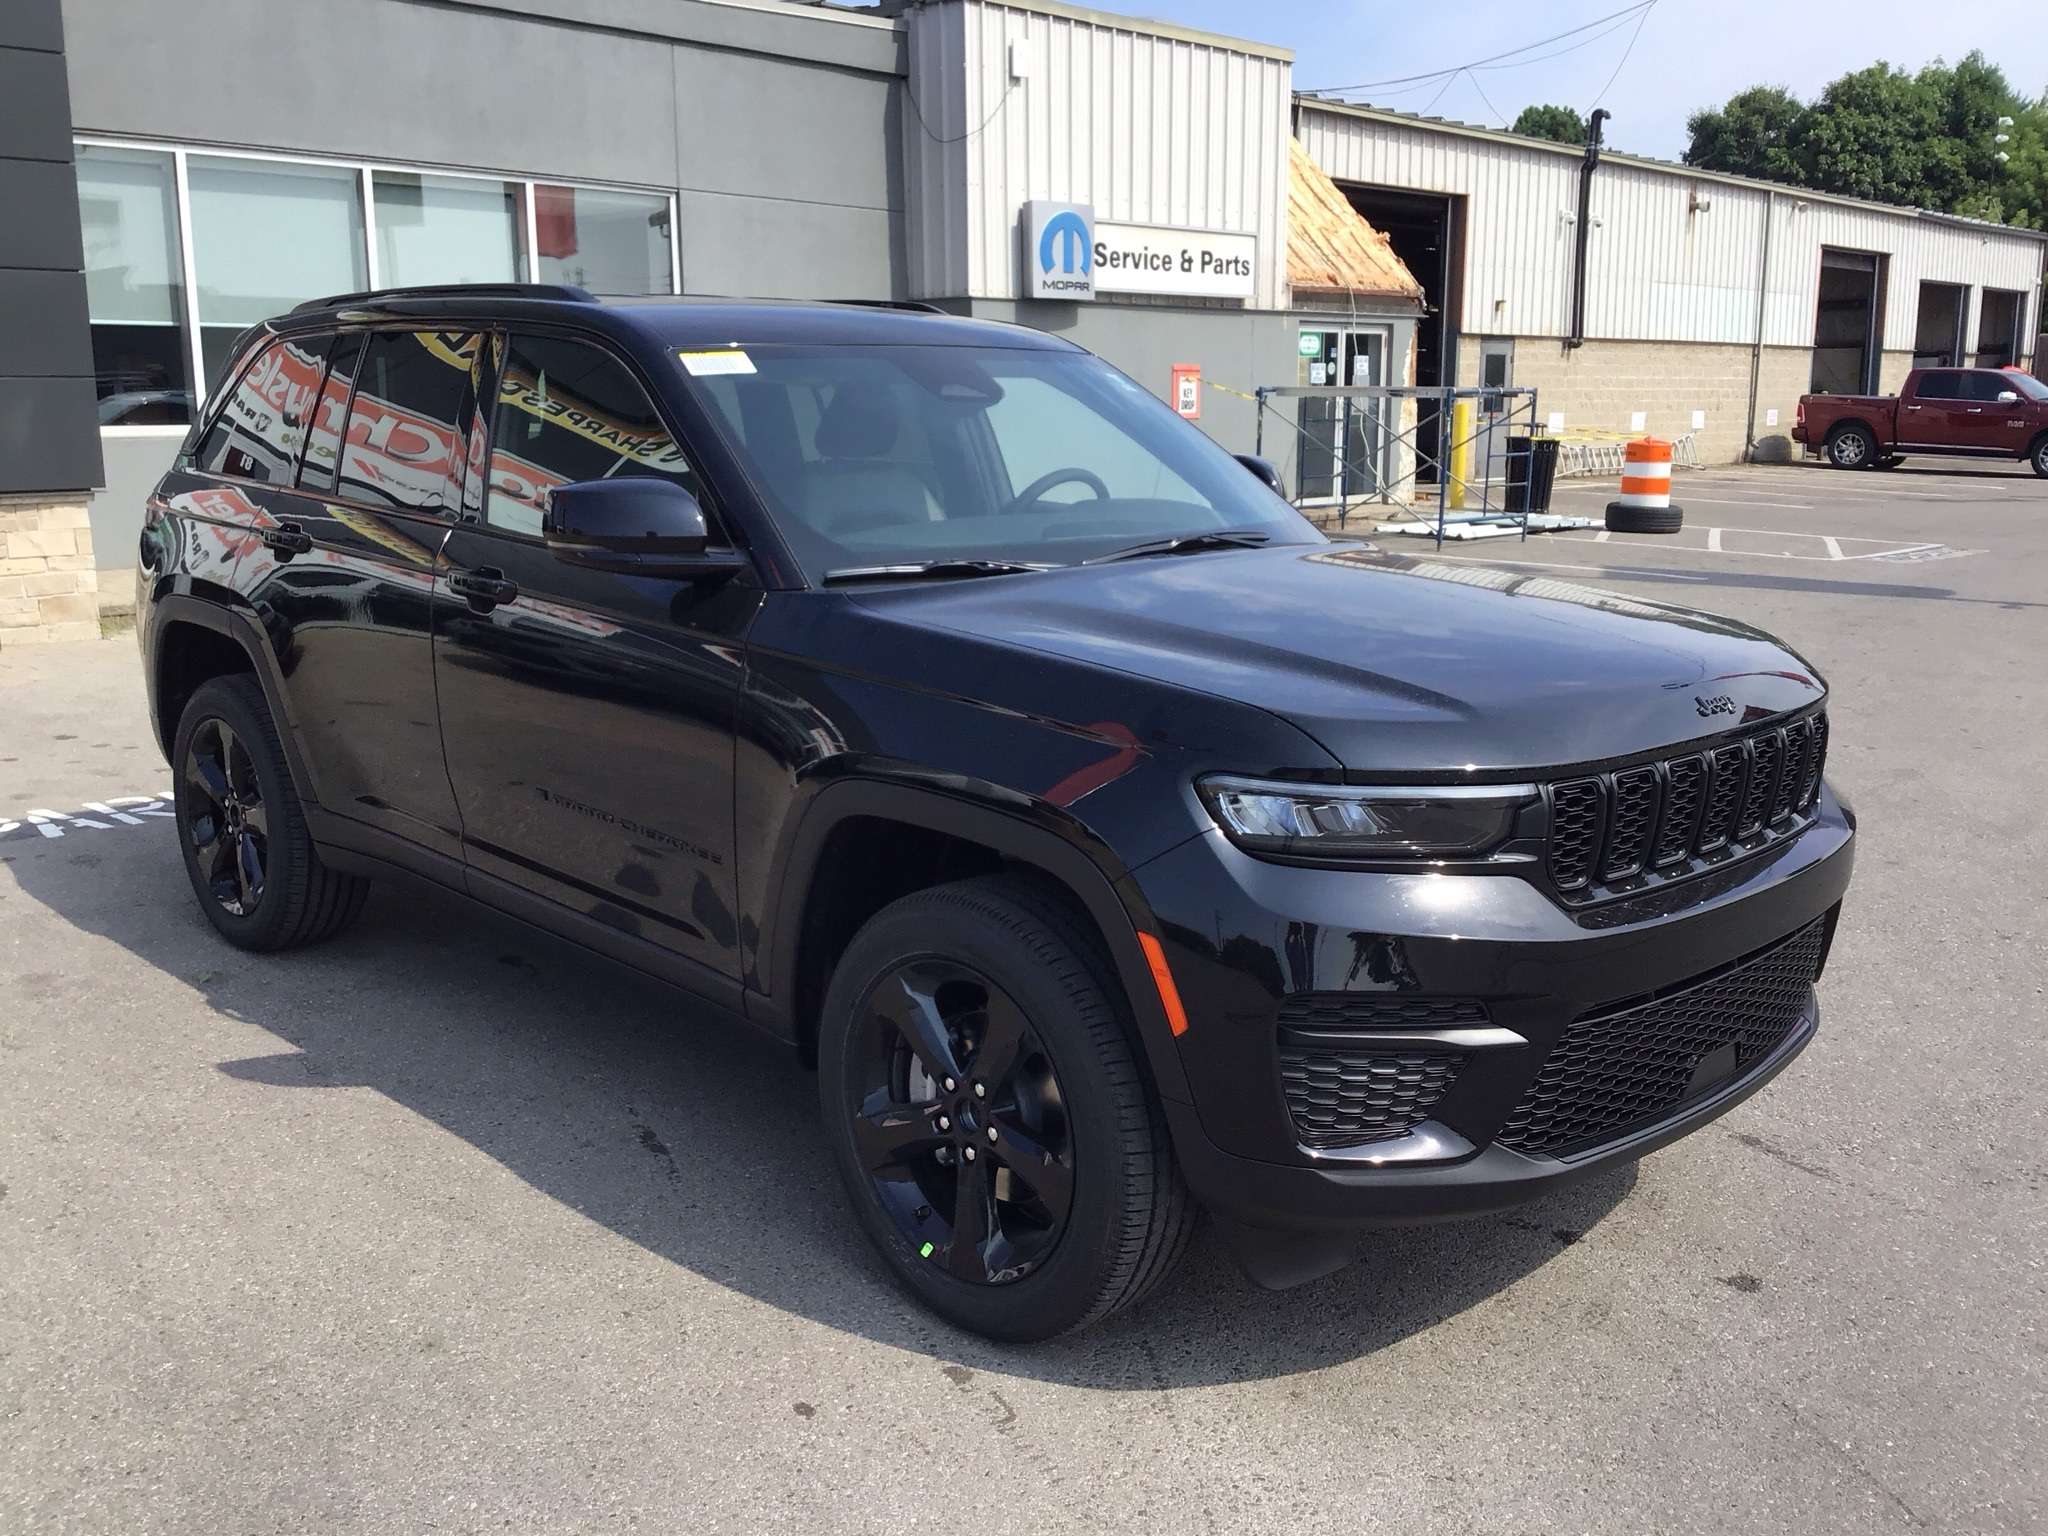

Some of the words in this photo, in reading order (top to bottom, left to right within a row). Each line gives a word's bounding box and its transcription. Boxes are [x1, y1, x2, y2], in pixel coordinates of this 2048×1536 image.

[1094, 242, 1172, 272] Service
[1180, 249, 1194, 273] &
[1201, 250, 1250, 277] Parts
[1042, 280, 1090, 292] MOPAR
